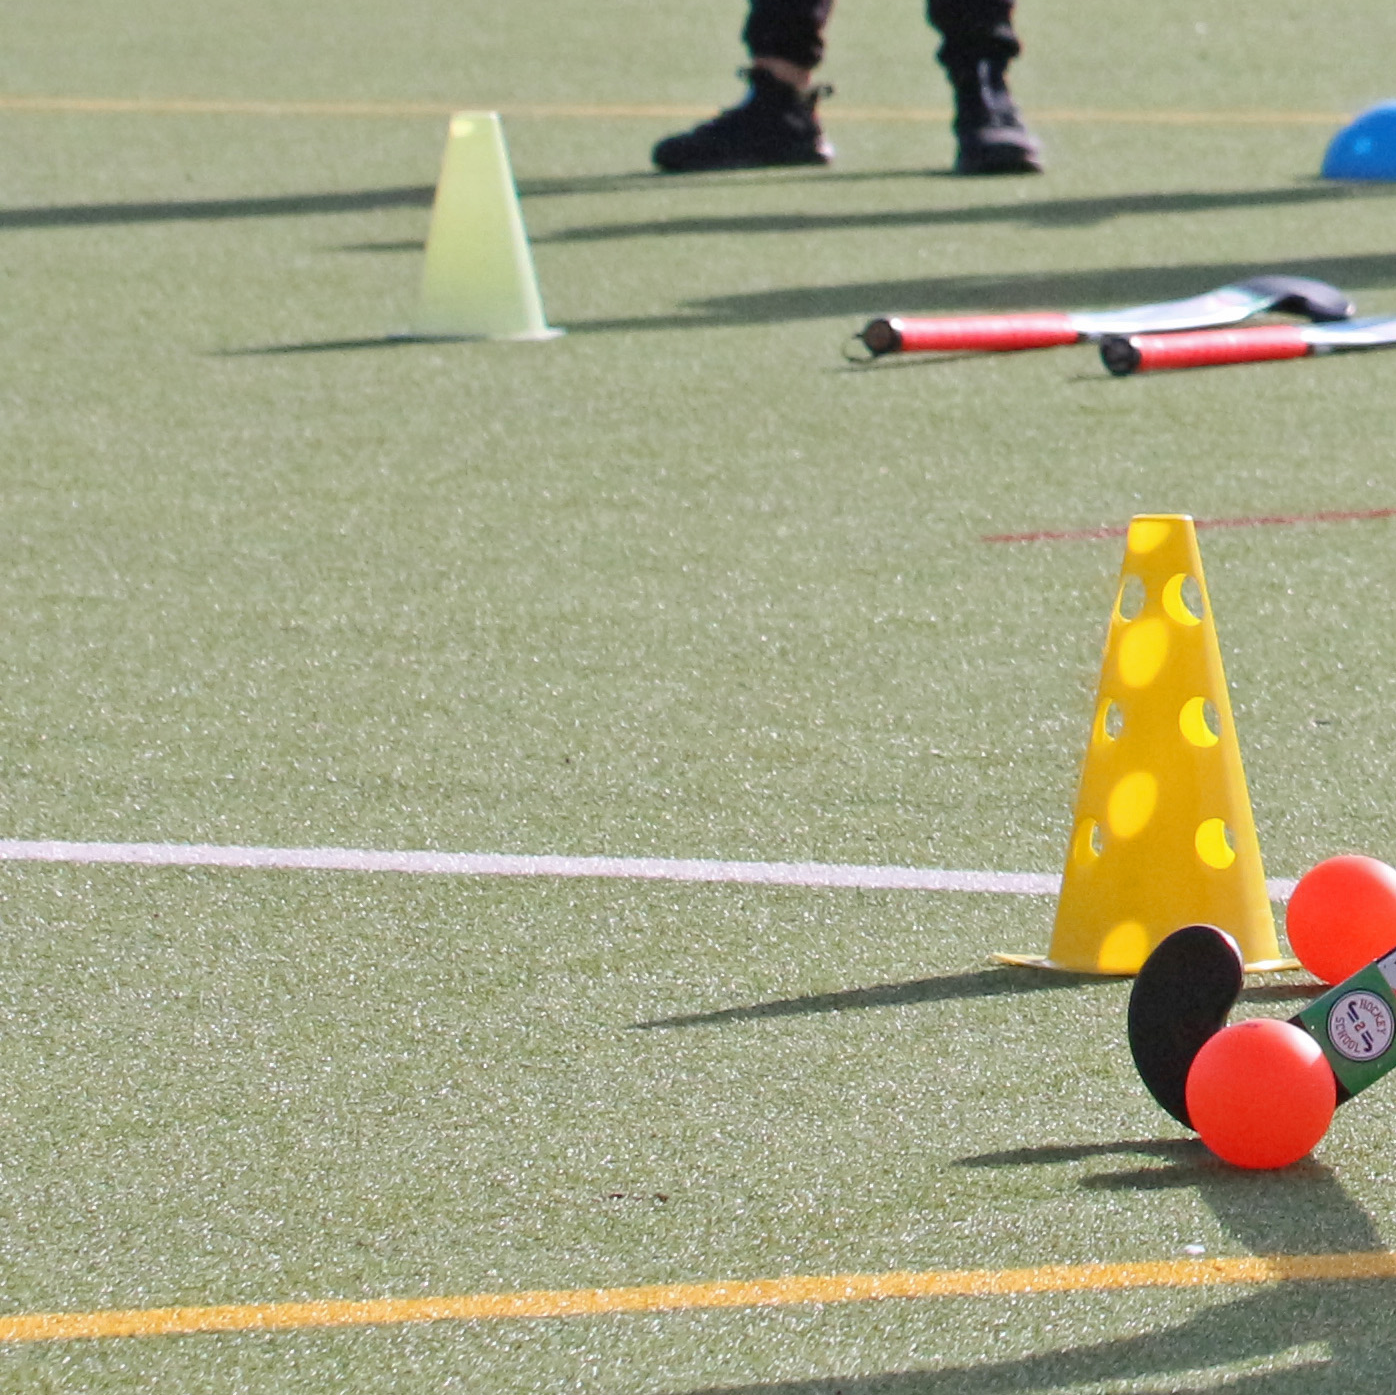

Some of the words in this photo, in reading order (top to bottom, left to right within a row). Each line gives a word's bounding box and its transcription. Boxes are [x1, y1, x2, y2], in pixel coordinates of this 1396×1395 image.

[1335, 1016, 1361, 1053] SCHOOL
[1354, 1021, 1366, 1032] 2
[1359, 998, 1387, 1035] HOCKEY
